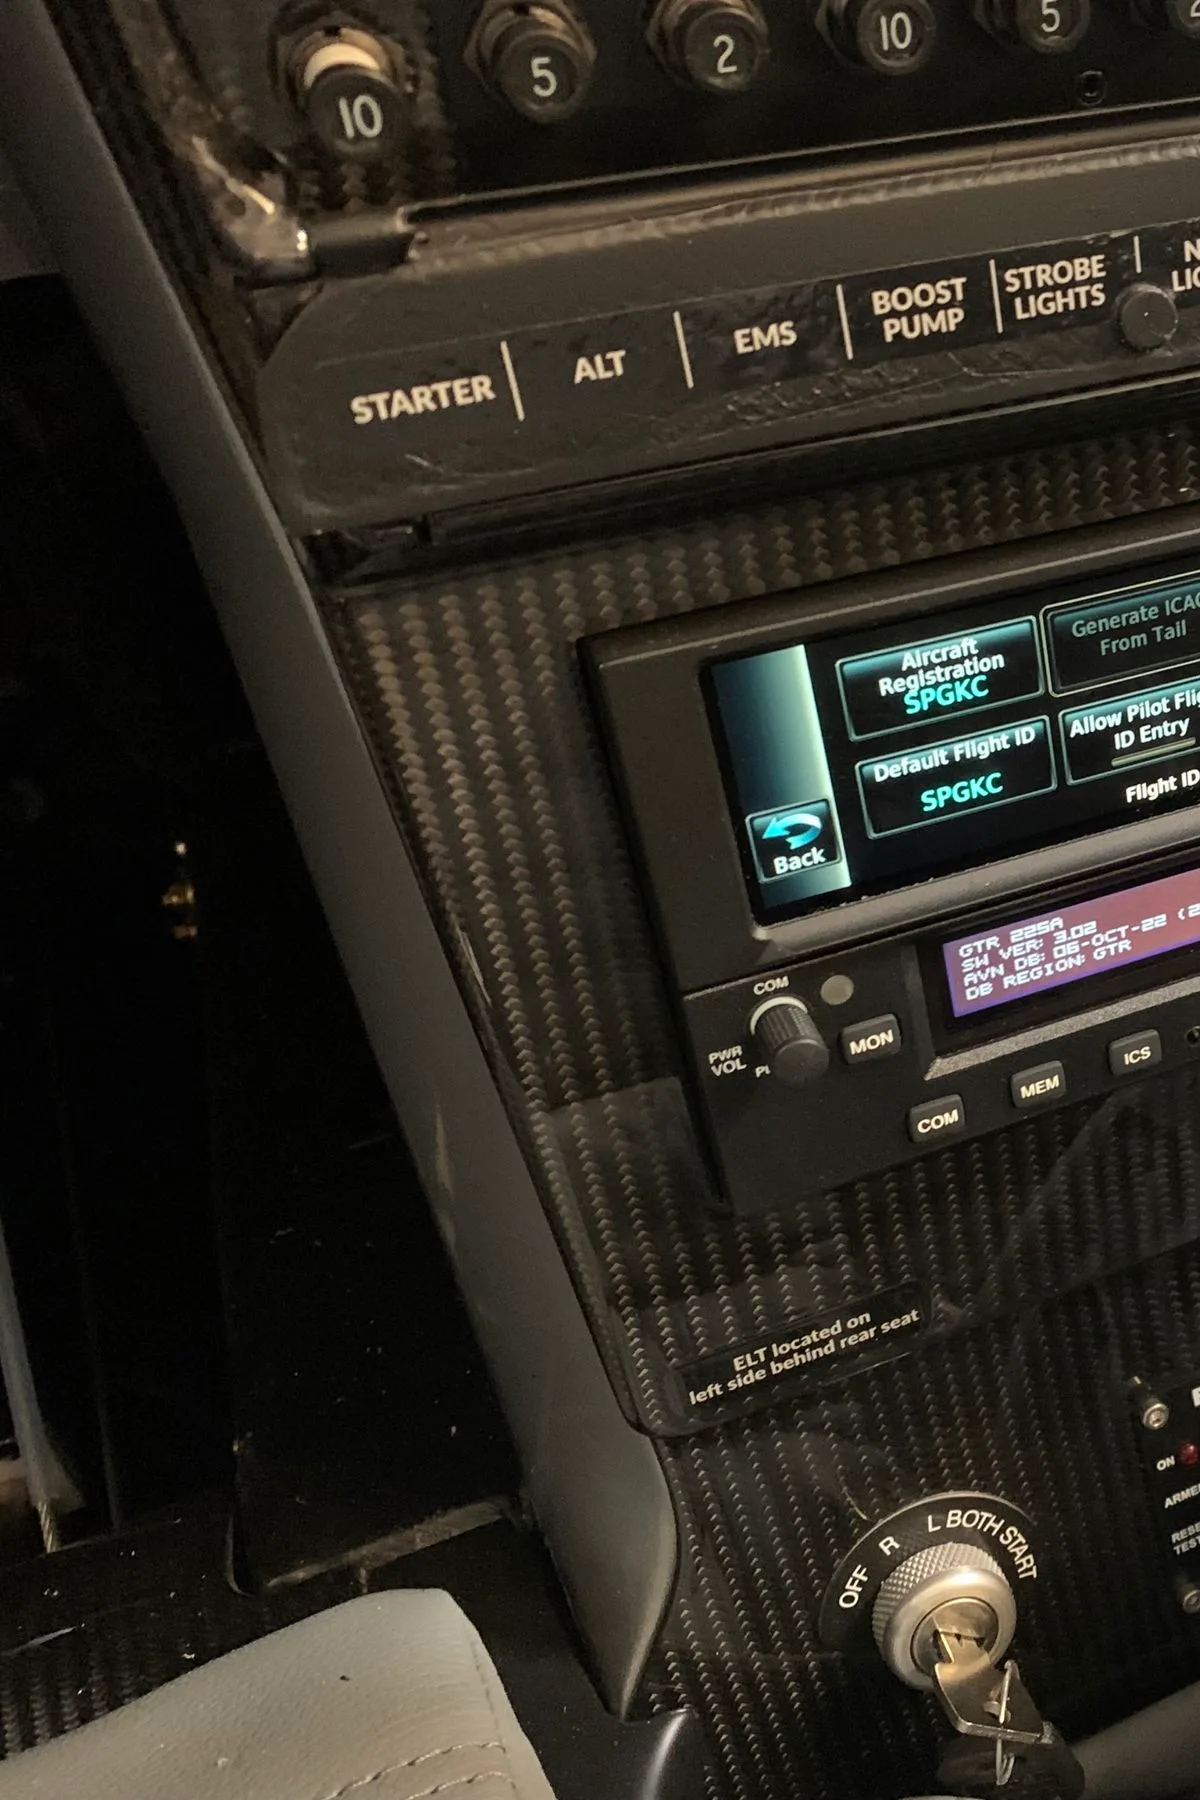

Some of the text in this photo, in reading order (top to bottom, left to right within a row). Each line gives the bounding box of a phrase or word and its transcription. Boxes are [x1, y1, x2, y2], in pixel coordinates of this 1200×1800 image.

[880, 12, 912, 50] 10
[1041, 0, 1061, 32] 5
[713, 35, 737, 73] 2
[531, 57, 557, 97] 5
[338, 94, 382, 139] 10
[1004, 255, 1106, 292] STROBE
[871, 277, 967, 315] BOOST
[1014, 283, 1106, 320] LIGHTS
[734, 321, 797, 354] EMS
[882, 307, 965, 343] PUMP
[574, 350, 625, 384] ALT
[351, 375, 496, 424] STARTER
[1071, 603, 1160, 640] Generate
[1100, 619, 1188, 657] From Tail
[901, 637, 979, 672] Aircraft
[879, 652, 1005, 698] Registration
[903, 674, 989, 715] SPGKC
[1069, 709, 1123, 739] Allow
[1126, 696, 1170, 725] Pilot
[1114, 716, 1191, 750] ID Entry
[873, 725, 1036, 784] Default Flight ID
[920, 772, 1004, 813] SPGKC
[1125, 768, 1200, 804] Flight ID
[773, 847, 827, 876] Back
[958, 917, 1064, 958] GTR 225A
[961, 920, 1097, 973] SW VER: 3.02
[964, 964, 1005, 987] AVN
[1014, 953, 1046, 972] DB:
[1052, 914, 1167, 959] 06-OCT-22
[753, 975, 790, 996] COM
[966, 939, 1132, 1001] DB REGION: GTR
[708, 1044, 743, 1065] PWR
[849, 1029, 894, 1056] MON
[1123, 1046, 1152, 1066] ICS
[710, 1058, 748, 1077] VOL
[1019, 1074, 1060, 1100] MEM
[917, 1109, 959, 1134] COM
[689, 1308, 921, 1405] left side behind rear seat
[733, 1312, 871, 1372] ELT located on
[1156, 1456, 1175, 1471] ON
[927, 1514, 941, 1532] L
[946, 1509, 1005, 1537] BOTH
[879, 1535, 900, 1556] R
[999, 1526, 1037, 1579] START
[839, 1564, 869, 1609] OFF
